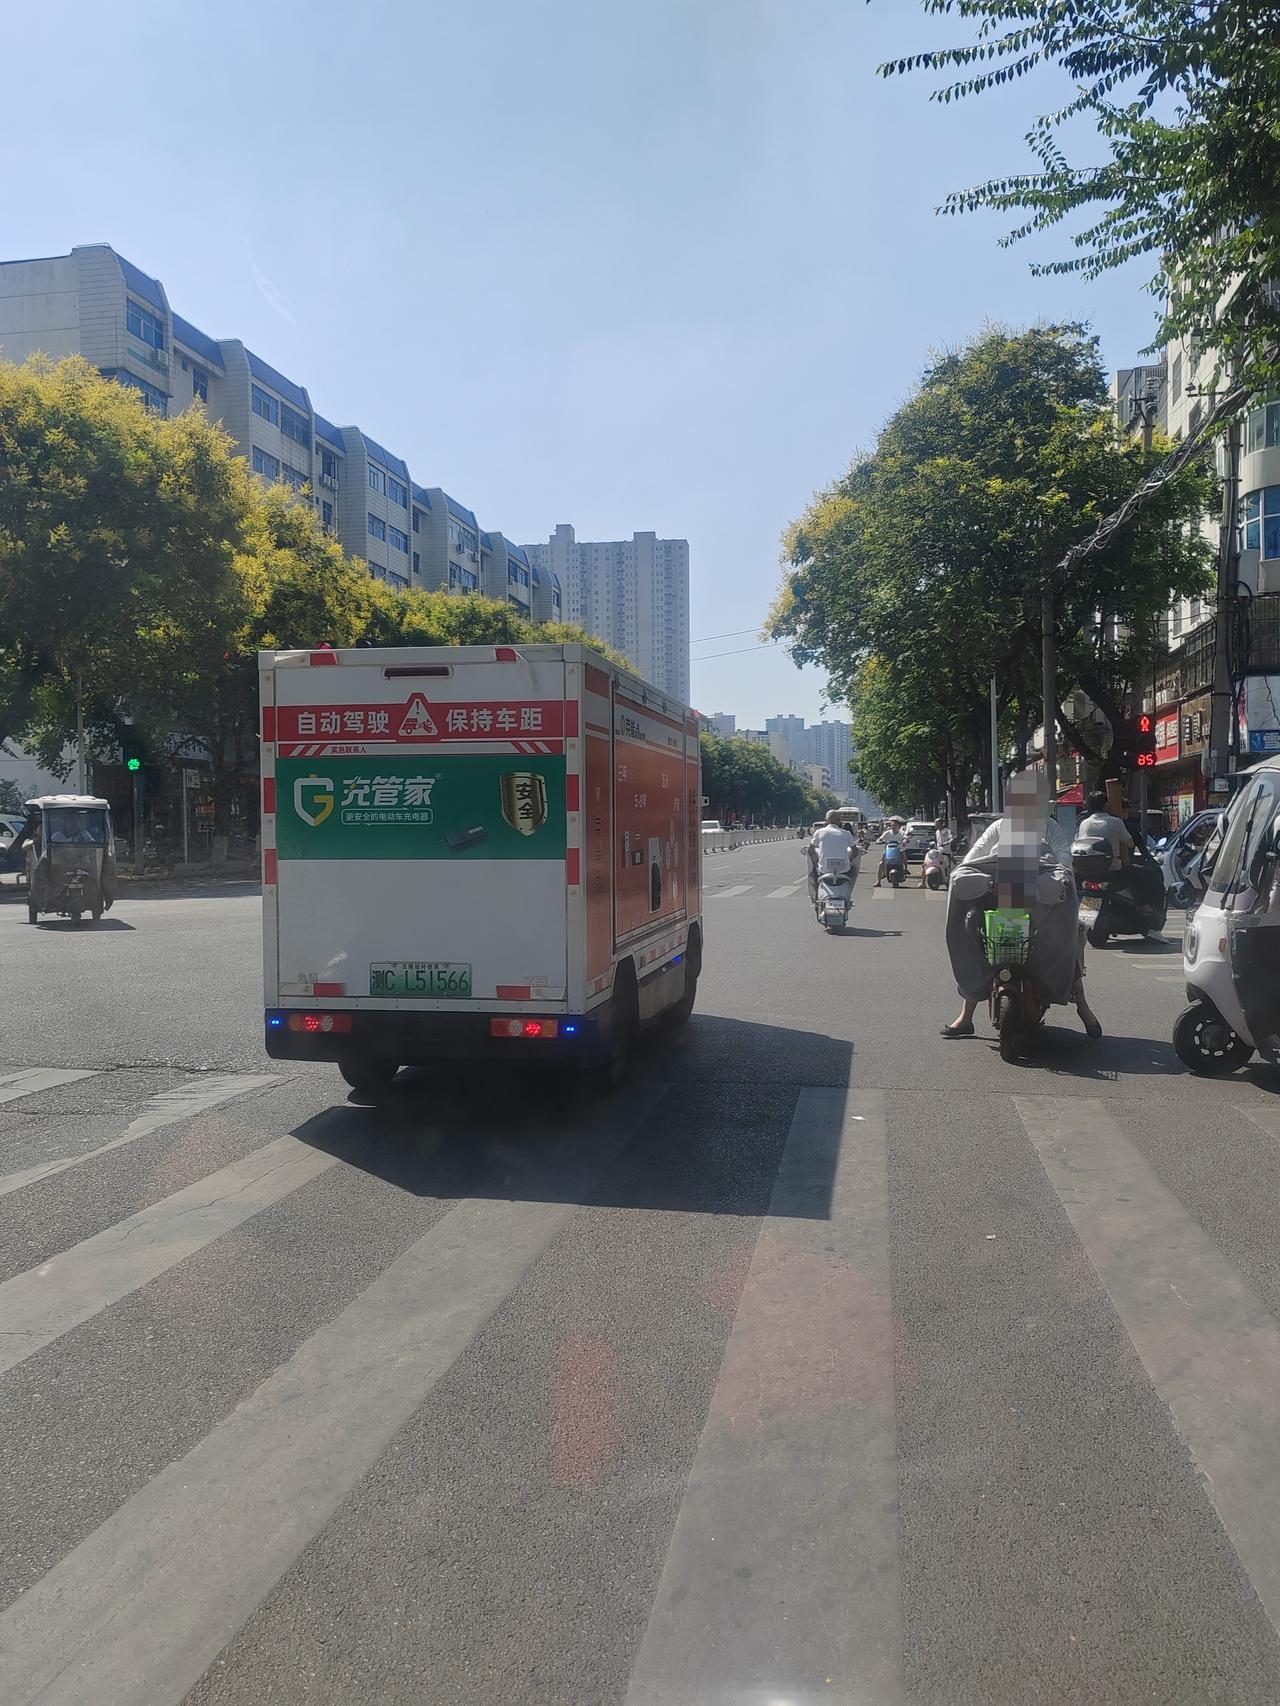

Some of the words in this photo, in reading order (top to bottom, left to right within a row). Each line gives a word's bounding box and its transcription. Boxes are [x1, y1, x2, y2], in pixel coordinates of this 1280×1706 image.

[297, 710, 390, 736] 自动驾驶
[445, 707, 544, 733] 保持车距
[330, 745, 368, 755] 紧急联系人
[340, 775, 436, 806] 充管家
[515, 783, 535, 819] 安全
[345, 811, 429, 821] 更安全的电动车充电器
